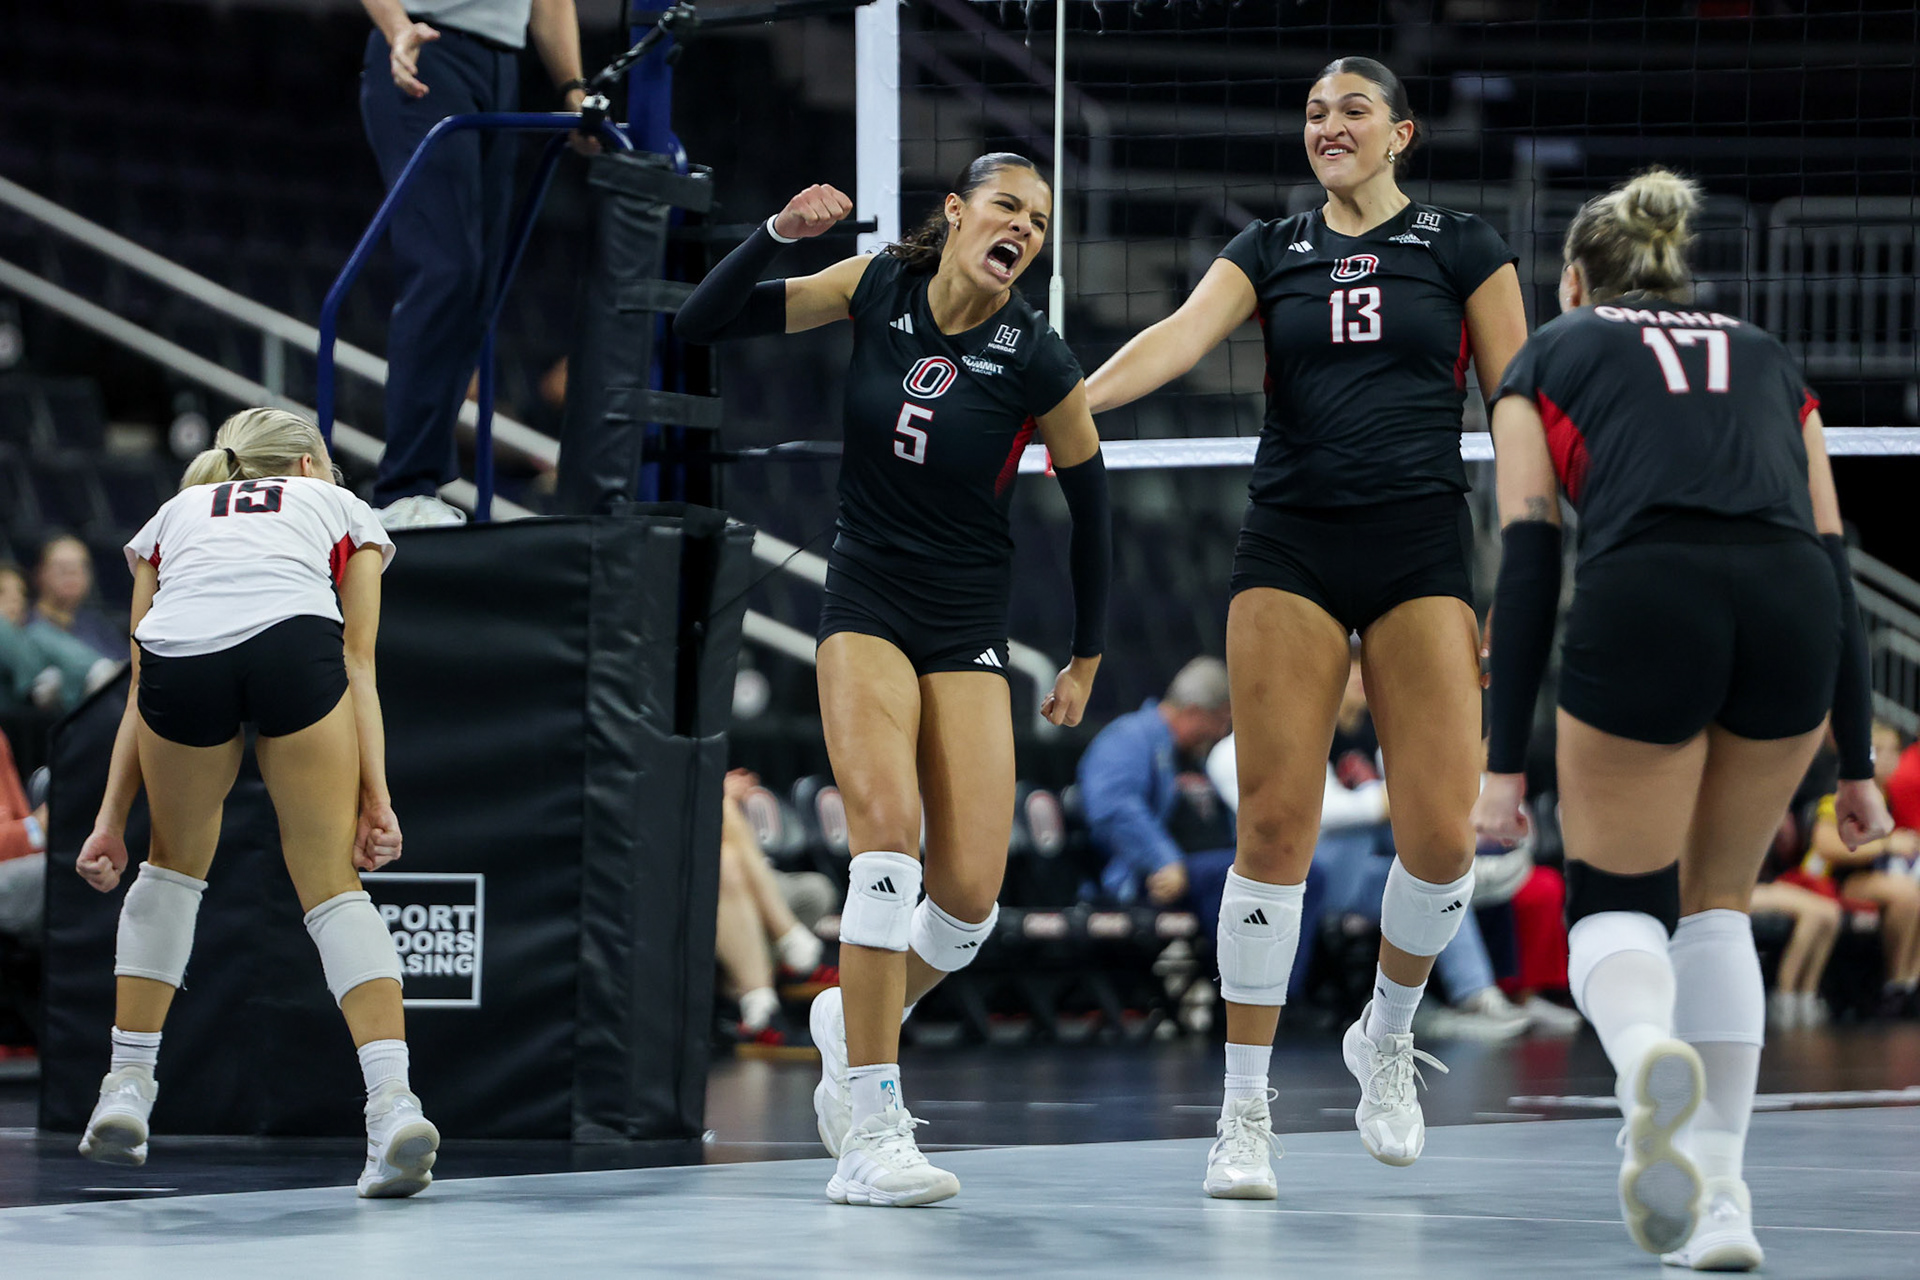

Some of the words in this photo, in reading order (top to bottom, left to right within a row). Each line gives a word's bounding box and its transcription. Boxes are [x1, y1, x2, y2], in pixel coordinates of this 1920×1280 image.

[1328, 286, 1382, 343] 13
[1594, 305, 1740, 327] OMAHA
[994, 324, 1021, 347] H
[961, 355, 1004, 375] SUMMIT
[1641, 326, 1730, 393] 17
[903, 356, 958, 399] O
[893, 401, 934, 465] 5
[210, 478, 288, 518] 15
[377, 904, 476, 932] PORT
[391, 930, 475, 954] OORS
